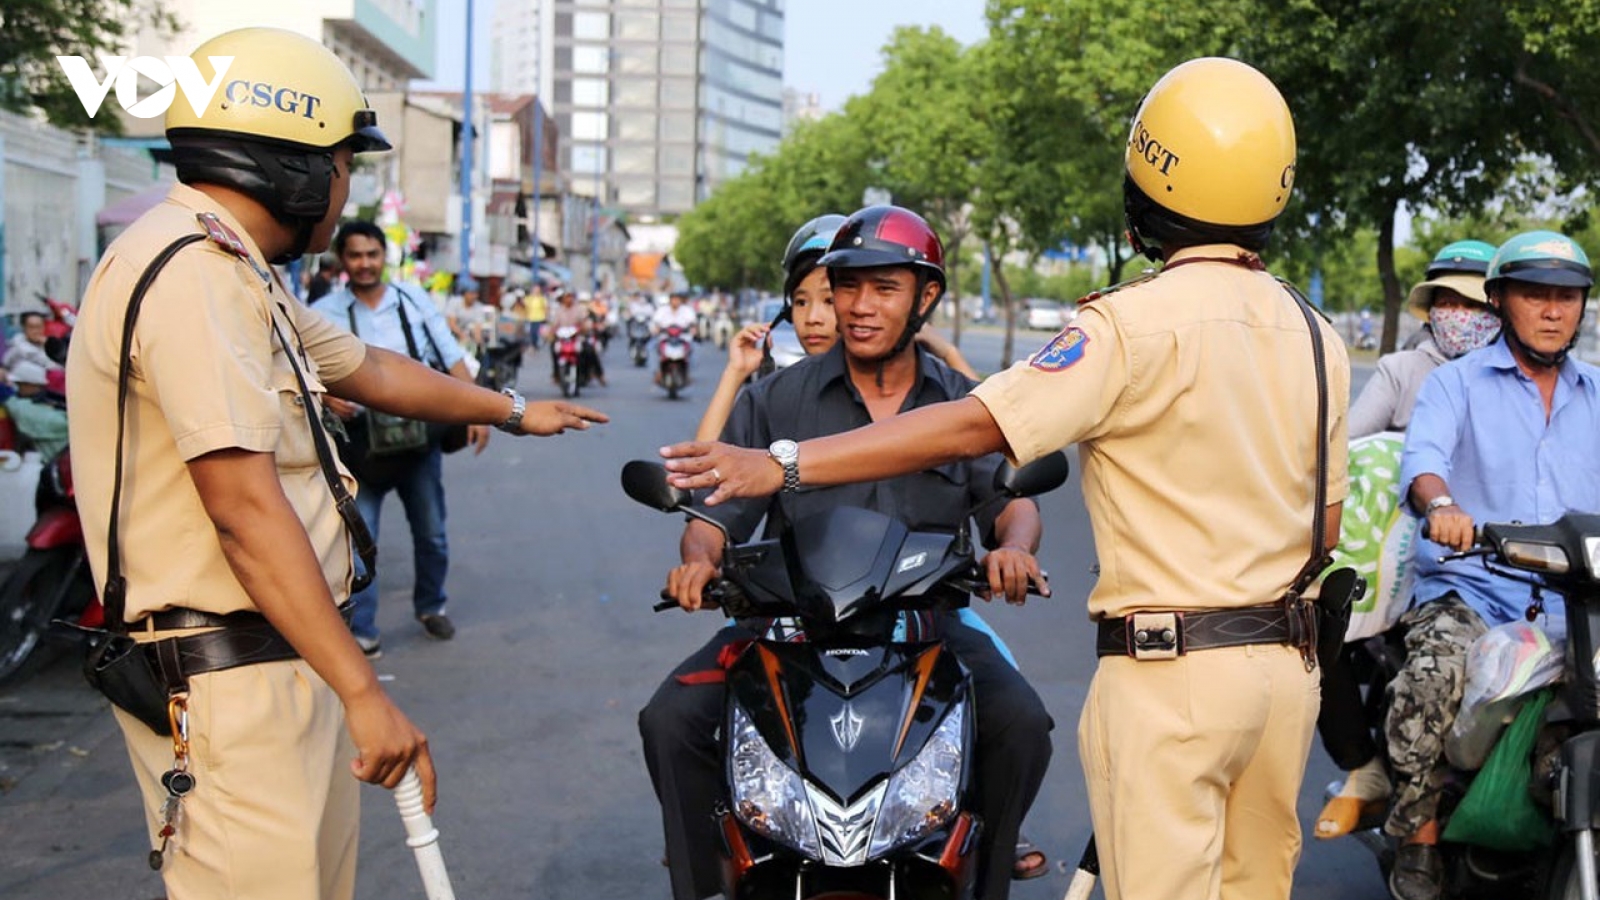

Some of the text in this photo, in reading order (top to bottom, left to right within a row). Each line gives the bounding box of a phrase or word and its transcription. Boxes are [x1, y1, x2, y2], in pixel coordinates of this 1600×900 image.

[225, 80, 320, 119] CSGT
[1133, 121, 1179, 176] CSGT
[825, 648, 870, 657] HONDA
